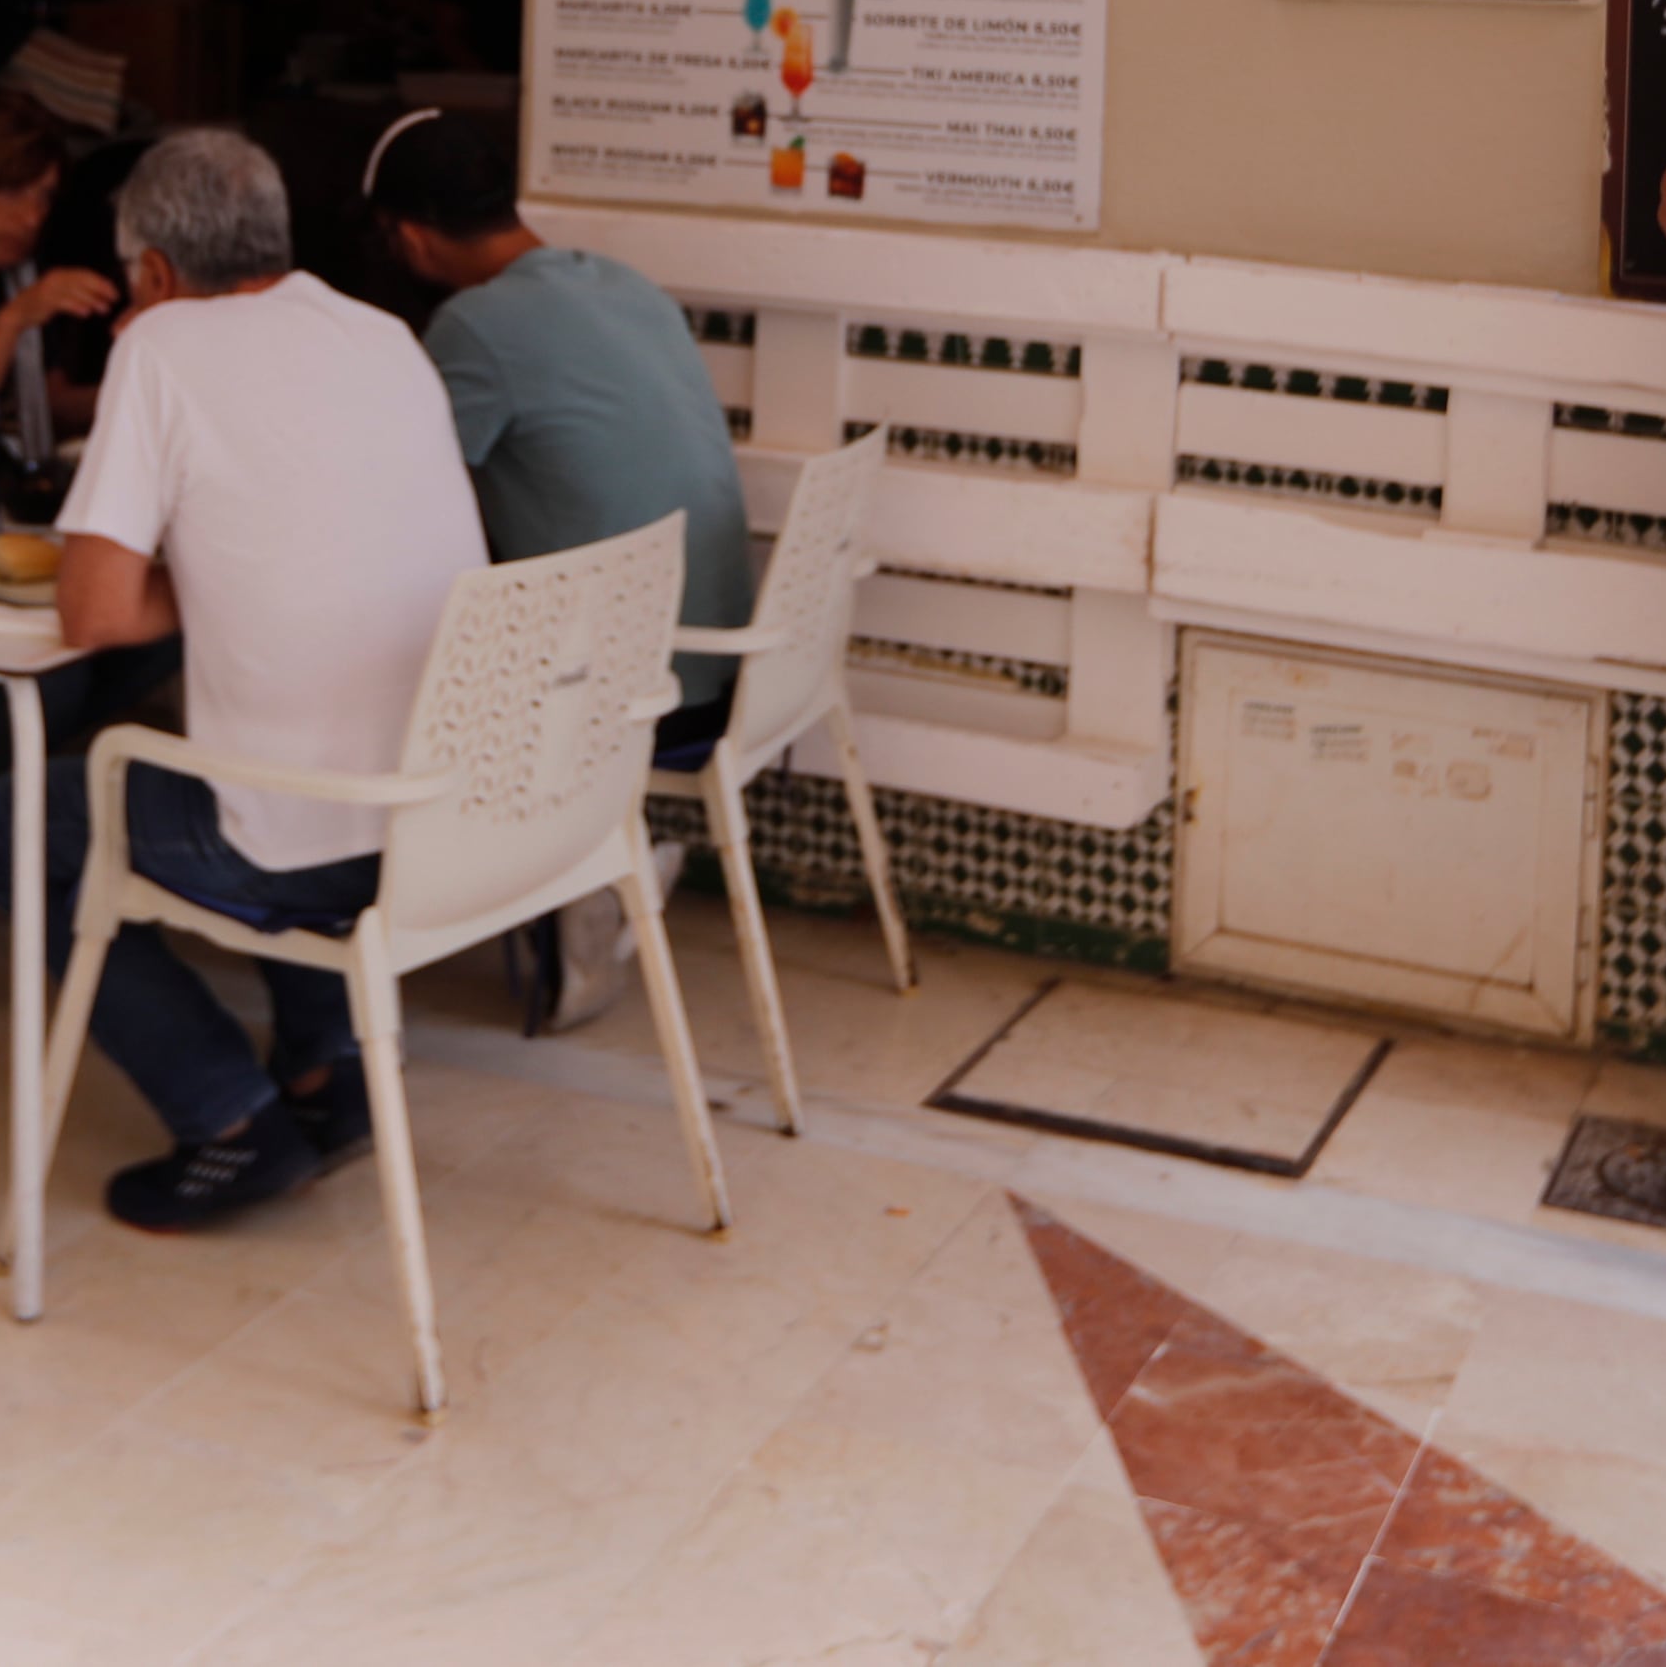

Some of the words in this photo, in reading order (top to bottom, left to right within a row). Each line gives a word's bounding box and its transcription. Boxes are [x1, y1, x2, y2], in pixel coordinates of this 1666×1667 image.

[863, 14, 938, 30] SORBETE
[944, 17, 967, 31] DE
[973, 16, 1028, 33] LIMÓN
[911, 67, 944, 80] TIKI
[949, 69, 1025, 86] AMERICA
[946, 121, 978, 135] MAI
[985, 123, 1024, 137] THAI
[925, 171, 1022, 191] VERMOUTH
